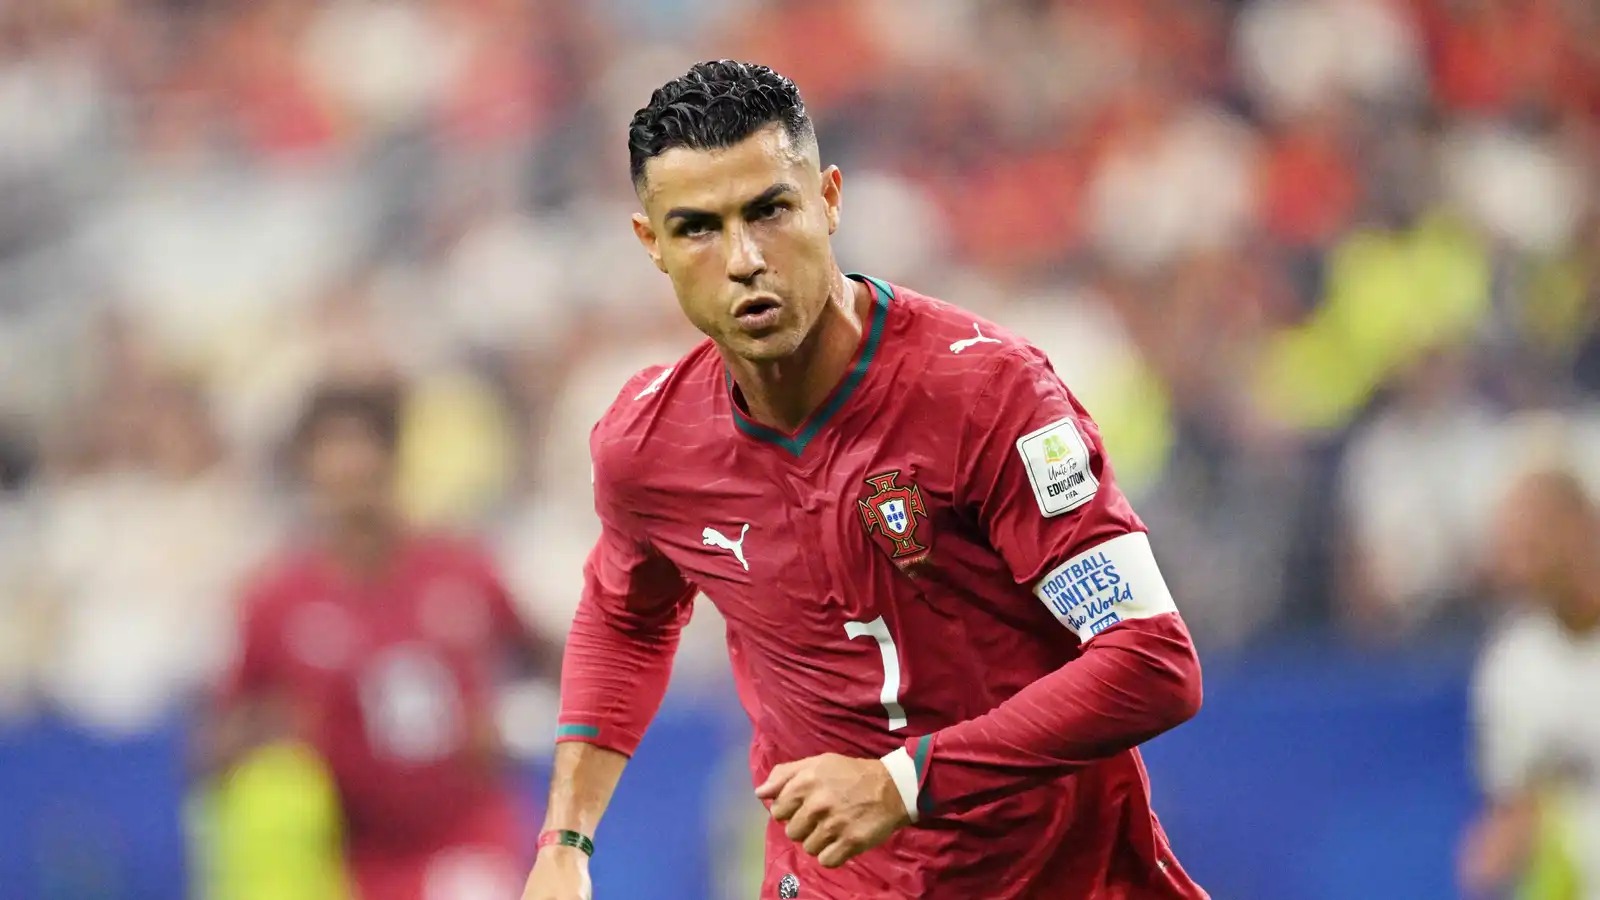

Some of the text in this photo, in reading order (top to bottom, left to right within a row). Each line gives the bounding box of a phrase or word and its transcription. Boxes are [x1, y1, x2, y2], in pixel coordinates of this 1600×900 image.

[1046, 470, 1085, 497] EDUCATION
[1047, 463, 1067, 481] Unite
[1065, 489, 1078, 500] FIFA
[1042, 552, 1111, 599] FOOTBALL
[1052, 565, 1120, 615] UNITES
[1067, 582, 1133, 631] the World
[1091, 614, 1119, 635] FIFA
[843, 614, 908, 732] 7
